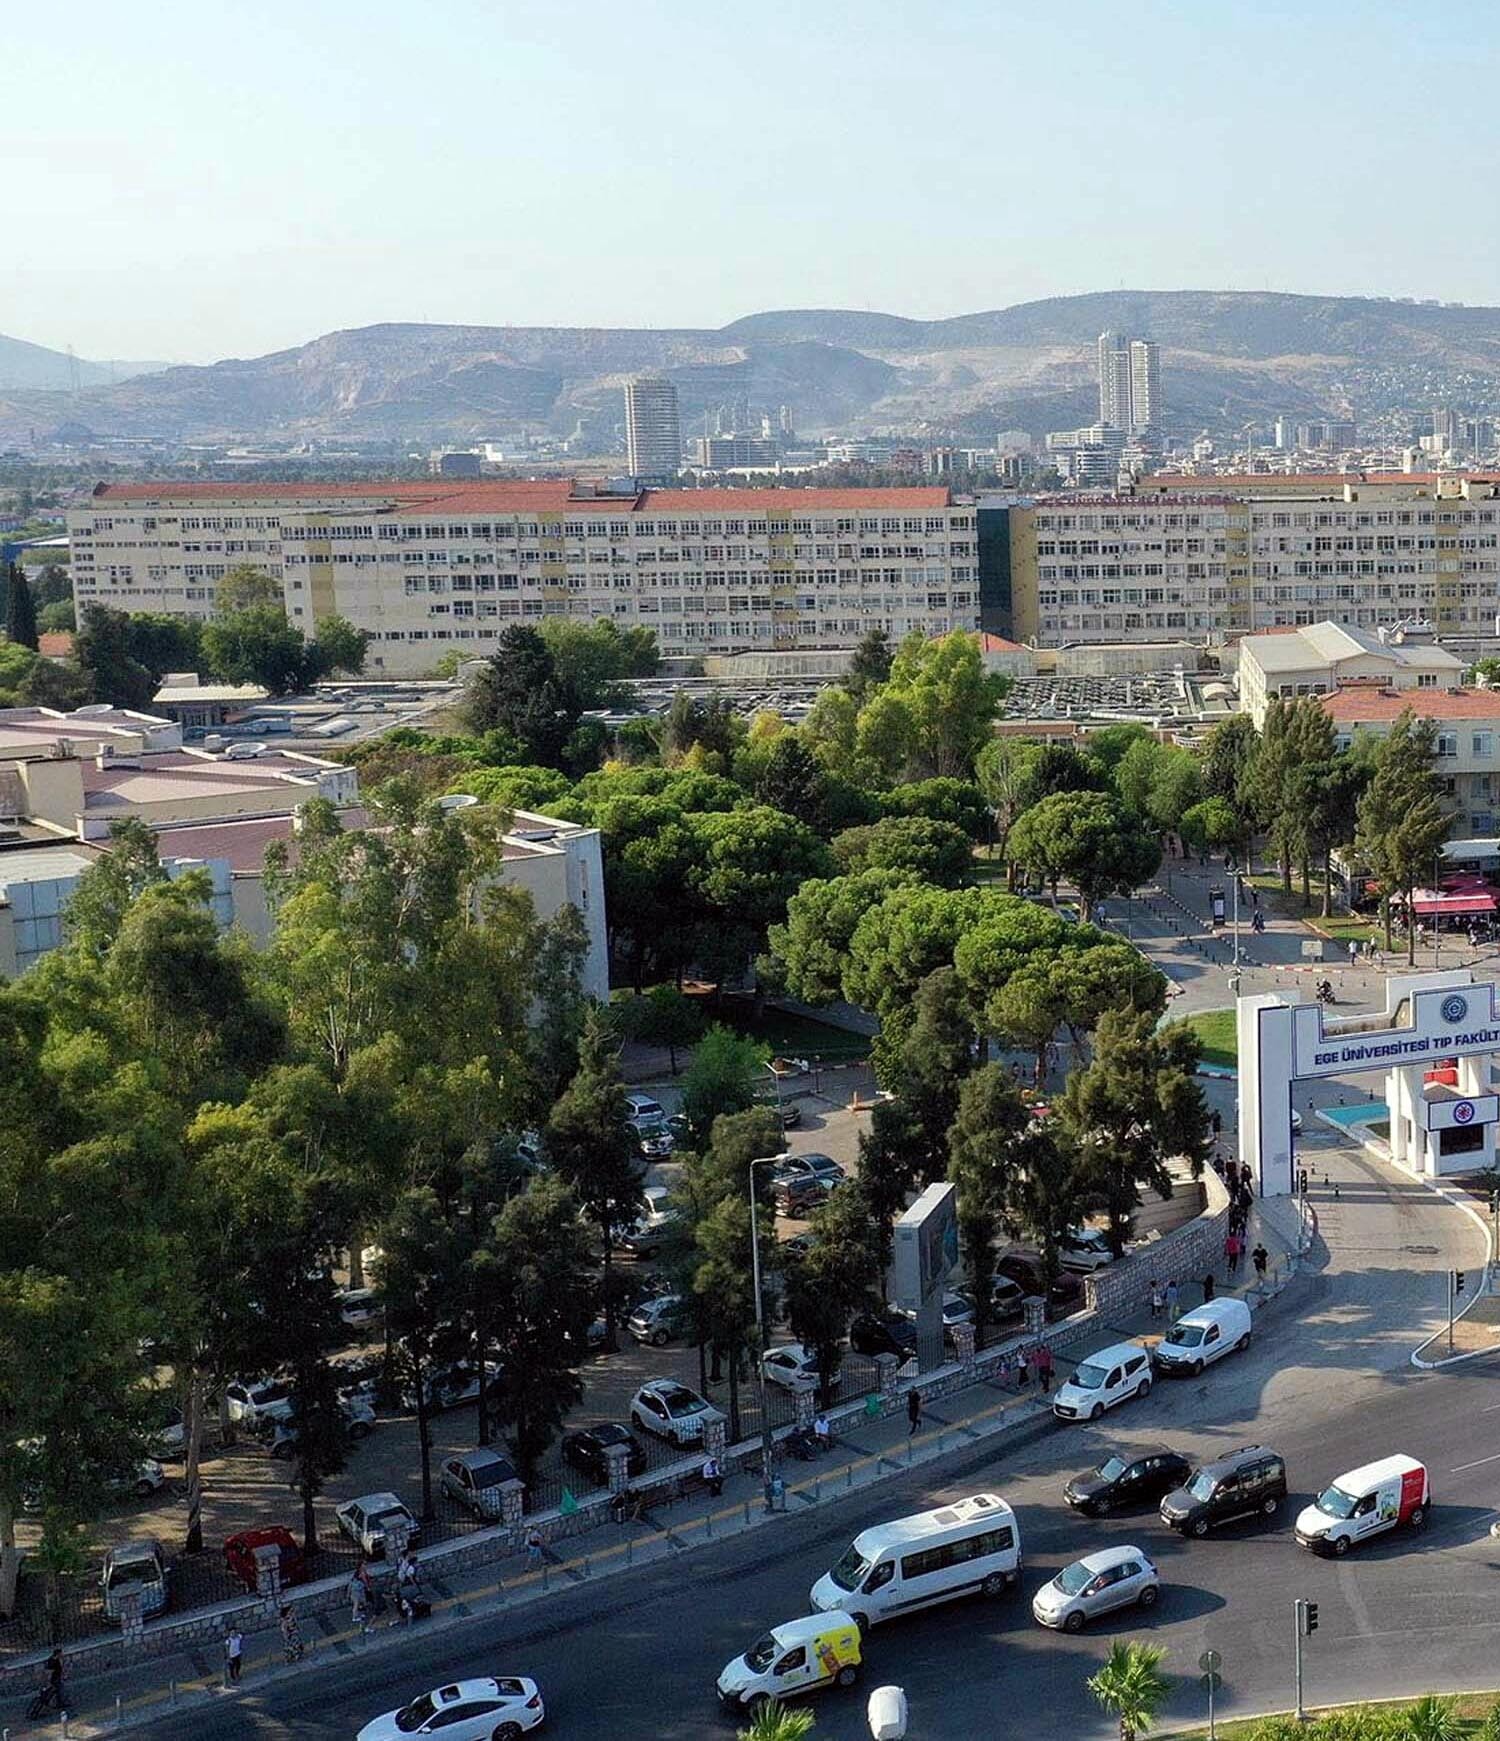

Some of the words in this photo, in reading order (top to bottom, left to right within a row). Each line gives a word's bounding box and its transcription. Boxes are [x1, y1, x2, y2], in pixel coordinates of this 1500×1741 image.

[1314, 1052, 1339, 1065] EGE
[1342, 1037, 1429, 1061] ÜNİVERSİTESİ
[1432, 1036, 1451, 1049] TIP
